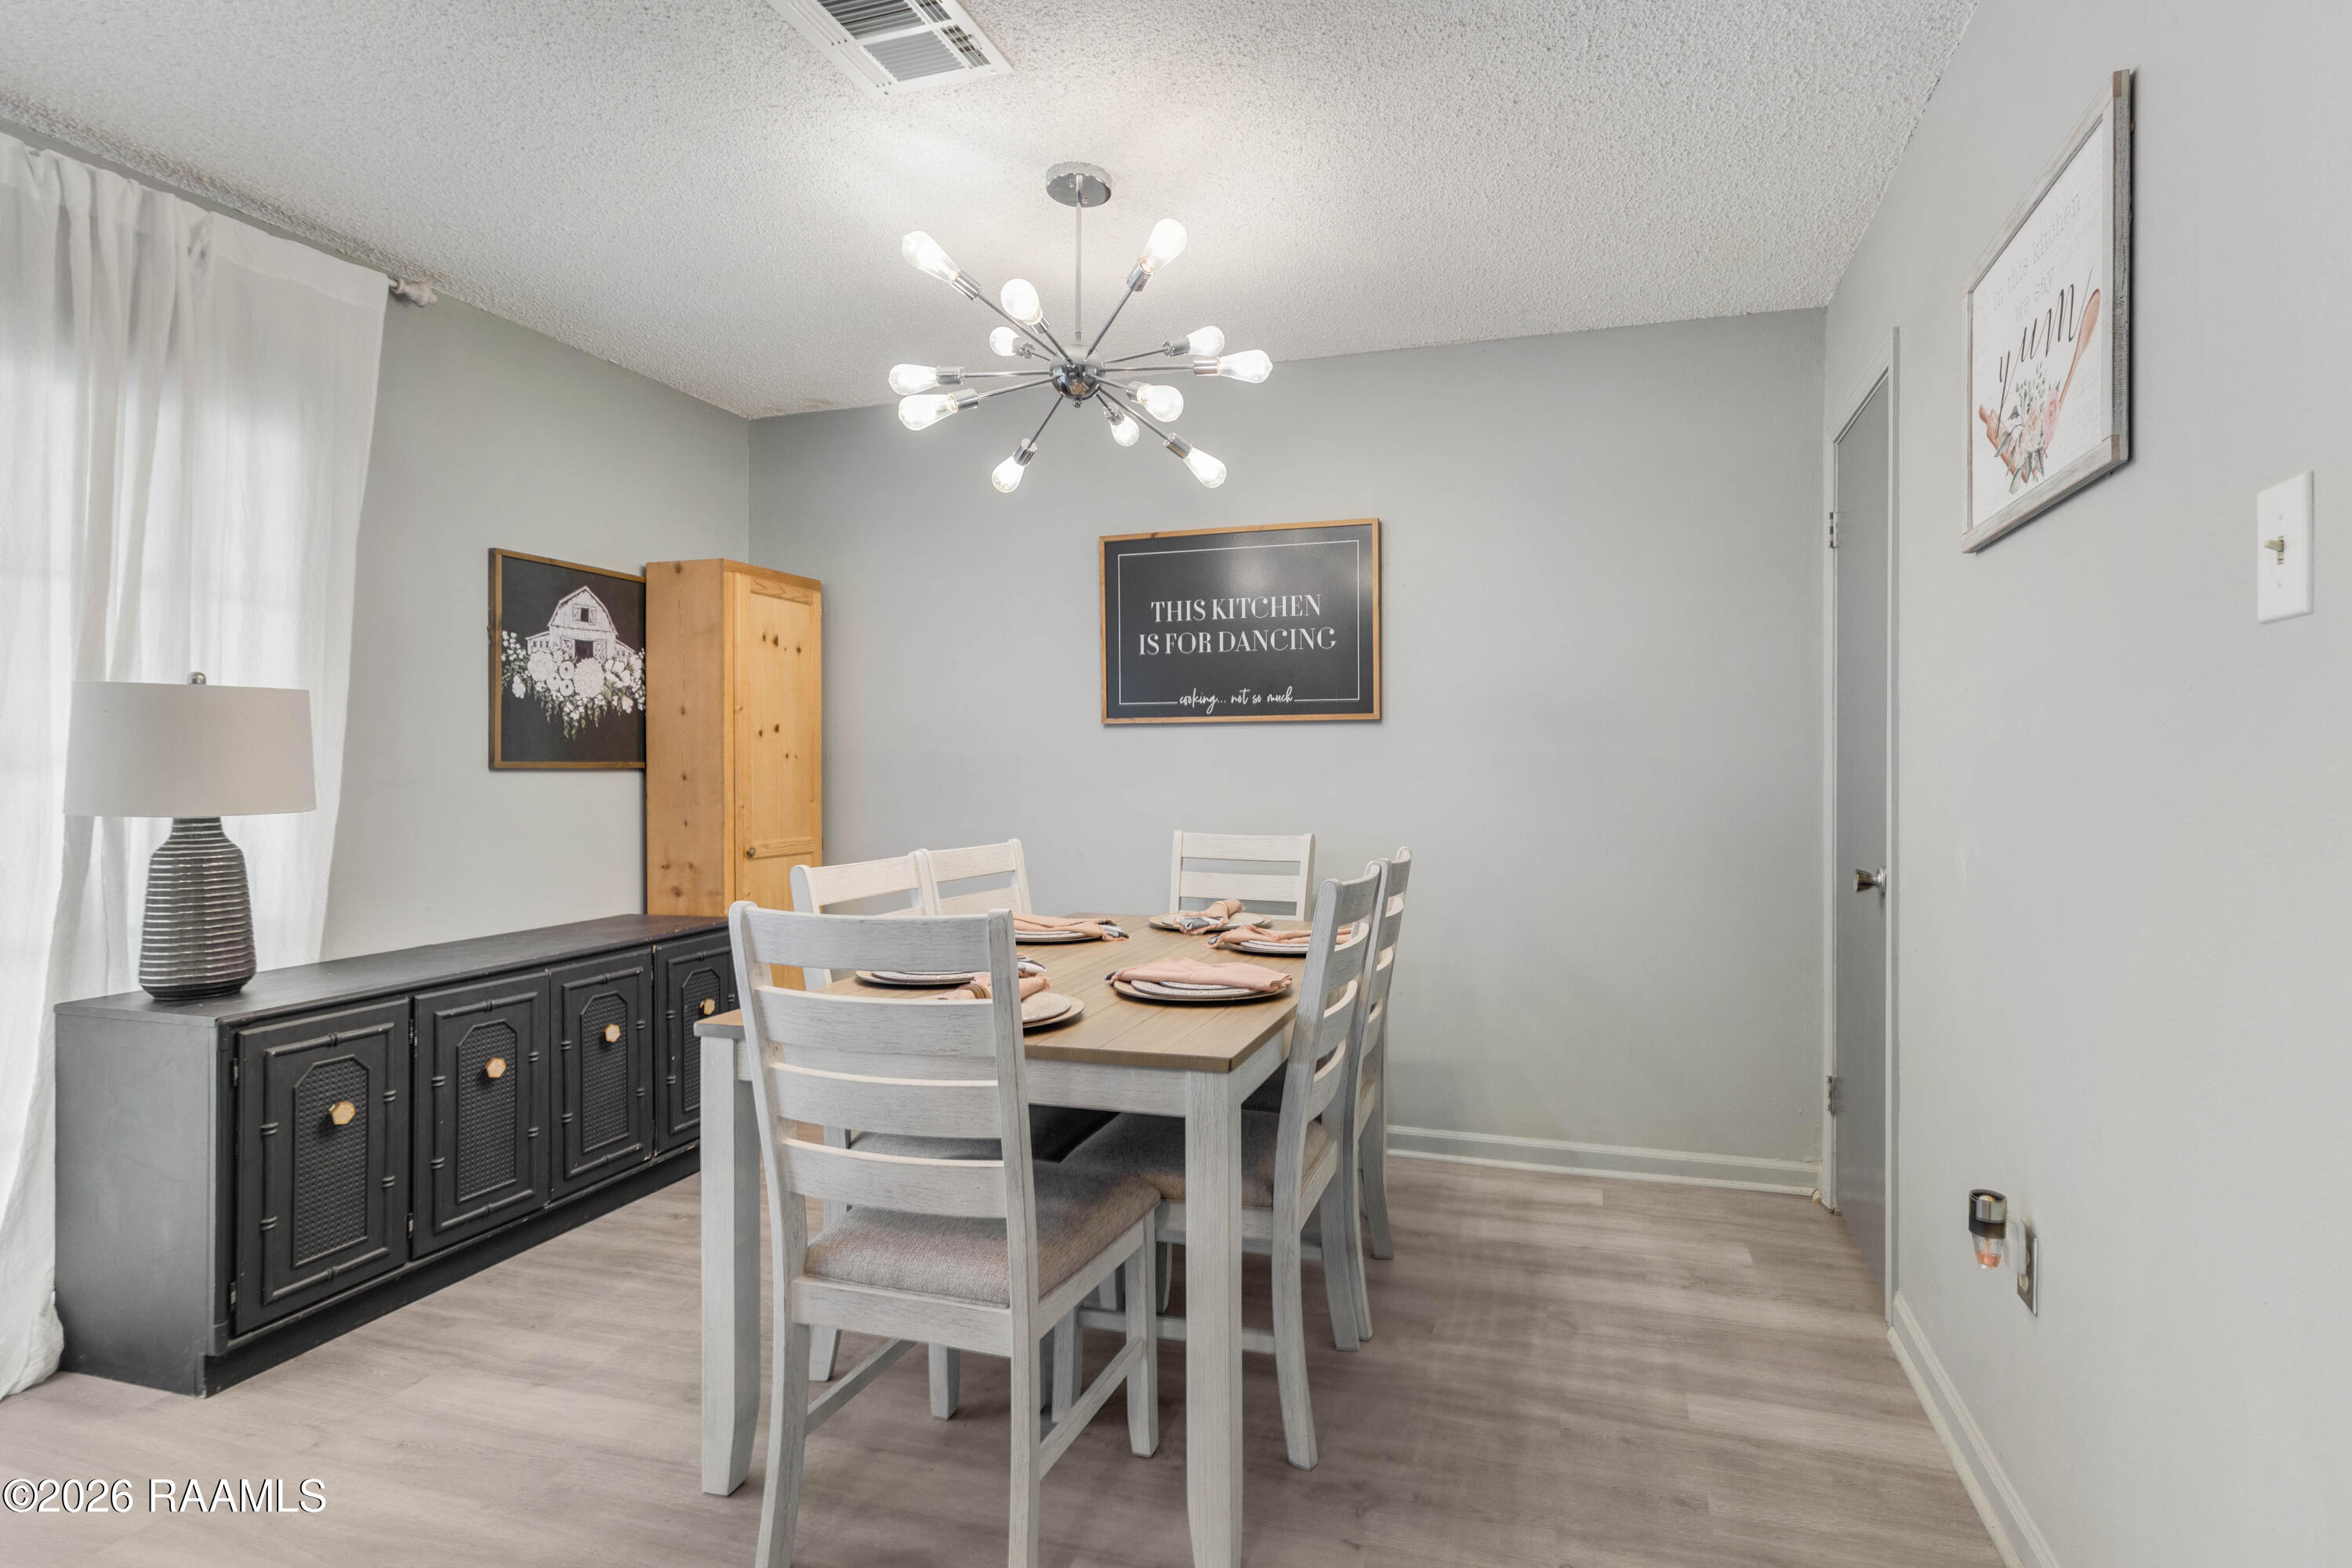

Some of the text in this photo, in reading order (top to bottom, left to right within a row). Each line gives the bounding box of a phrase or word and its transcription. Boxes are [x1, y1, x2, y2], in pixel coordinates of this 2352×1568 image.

[2007, 256, 2029, 294] this
[2032, 194, 2081, 264] kitchen
[2015, 295, 2031, 322] we
[1994, 267, 2093, 439] yum
[1151, 593, 1322, 622] THIS KITCHEN
[1139, 626, 1337, 655] IS FOR DANCING
[1179, 686, 1294, 714] cooking... not so much
